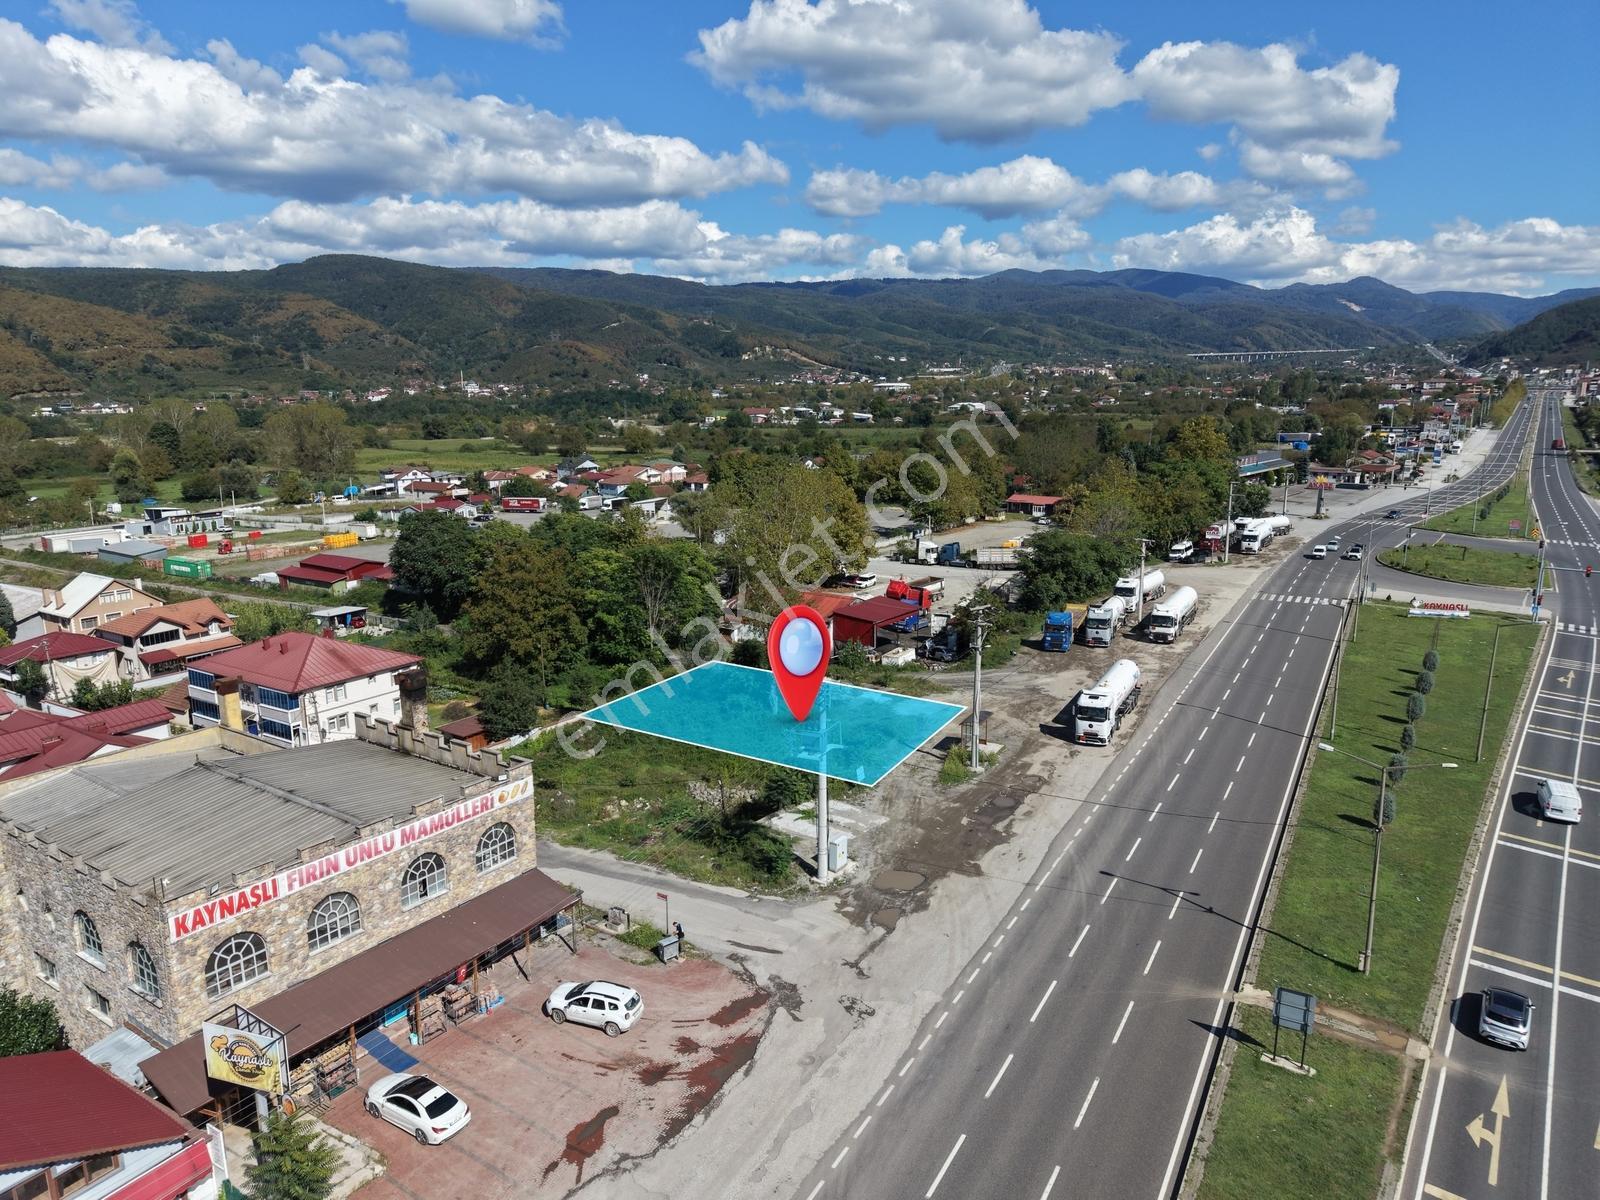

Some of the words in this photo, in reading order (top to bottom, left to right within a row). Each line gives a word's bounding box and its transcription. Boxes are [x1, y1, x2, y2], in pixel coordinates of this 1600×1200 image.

[174, 878, 279, 938] KAYNAŞLI
[286, 854, 340, 892] FIRIN
[345, 832, 395, 868] UNLU
[400, 793, 495, 847] MAMÜLLERİ
